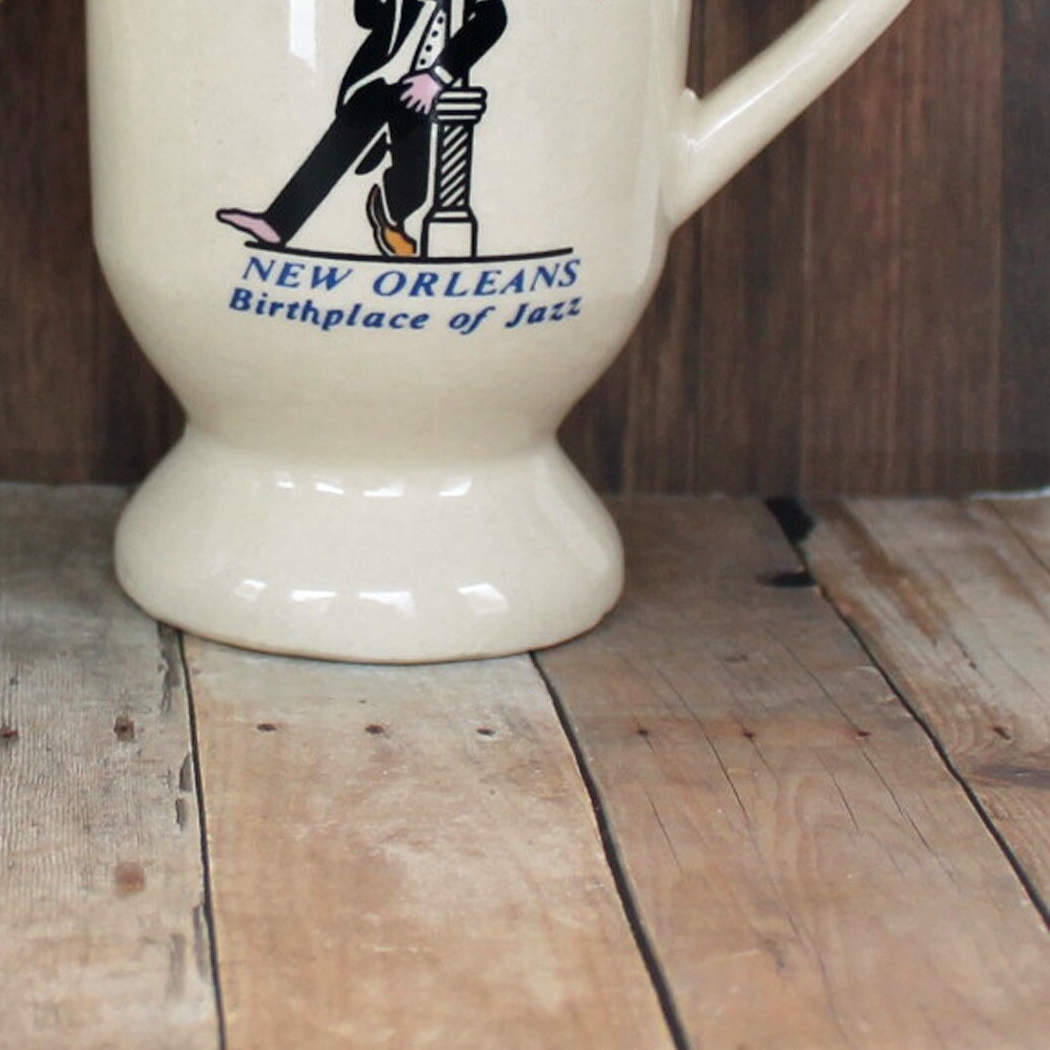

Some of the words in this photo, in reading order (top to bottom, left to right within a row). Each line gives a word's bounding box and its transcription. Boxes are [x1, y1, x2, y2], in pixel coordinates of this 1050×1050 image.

[242, 256, 353, 291] NEW
[373, 259, 581, 297] ORLEANS
[228, 287, 430, 332] Birthplace
[449, 306, 495, 335] of
[505, 297, 582, 329] Jazz
